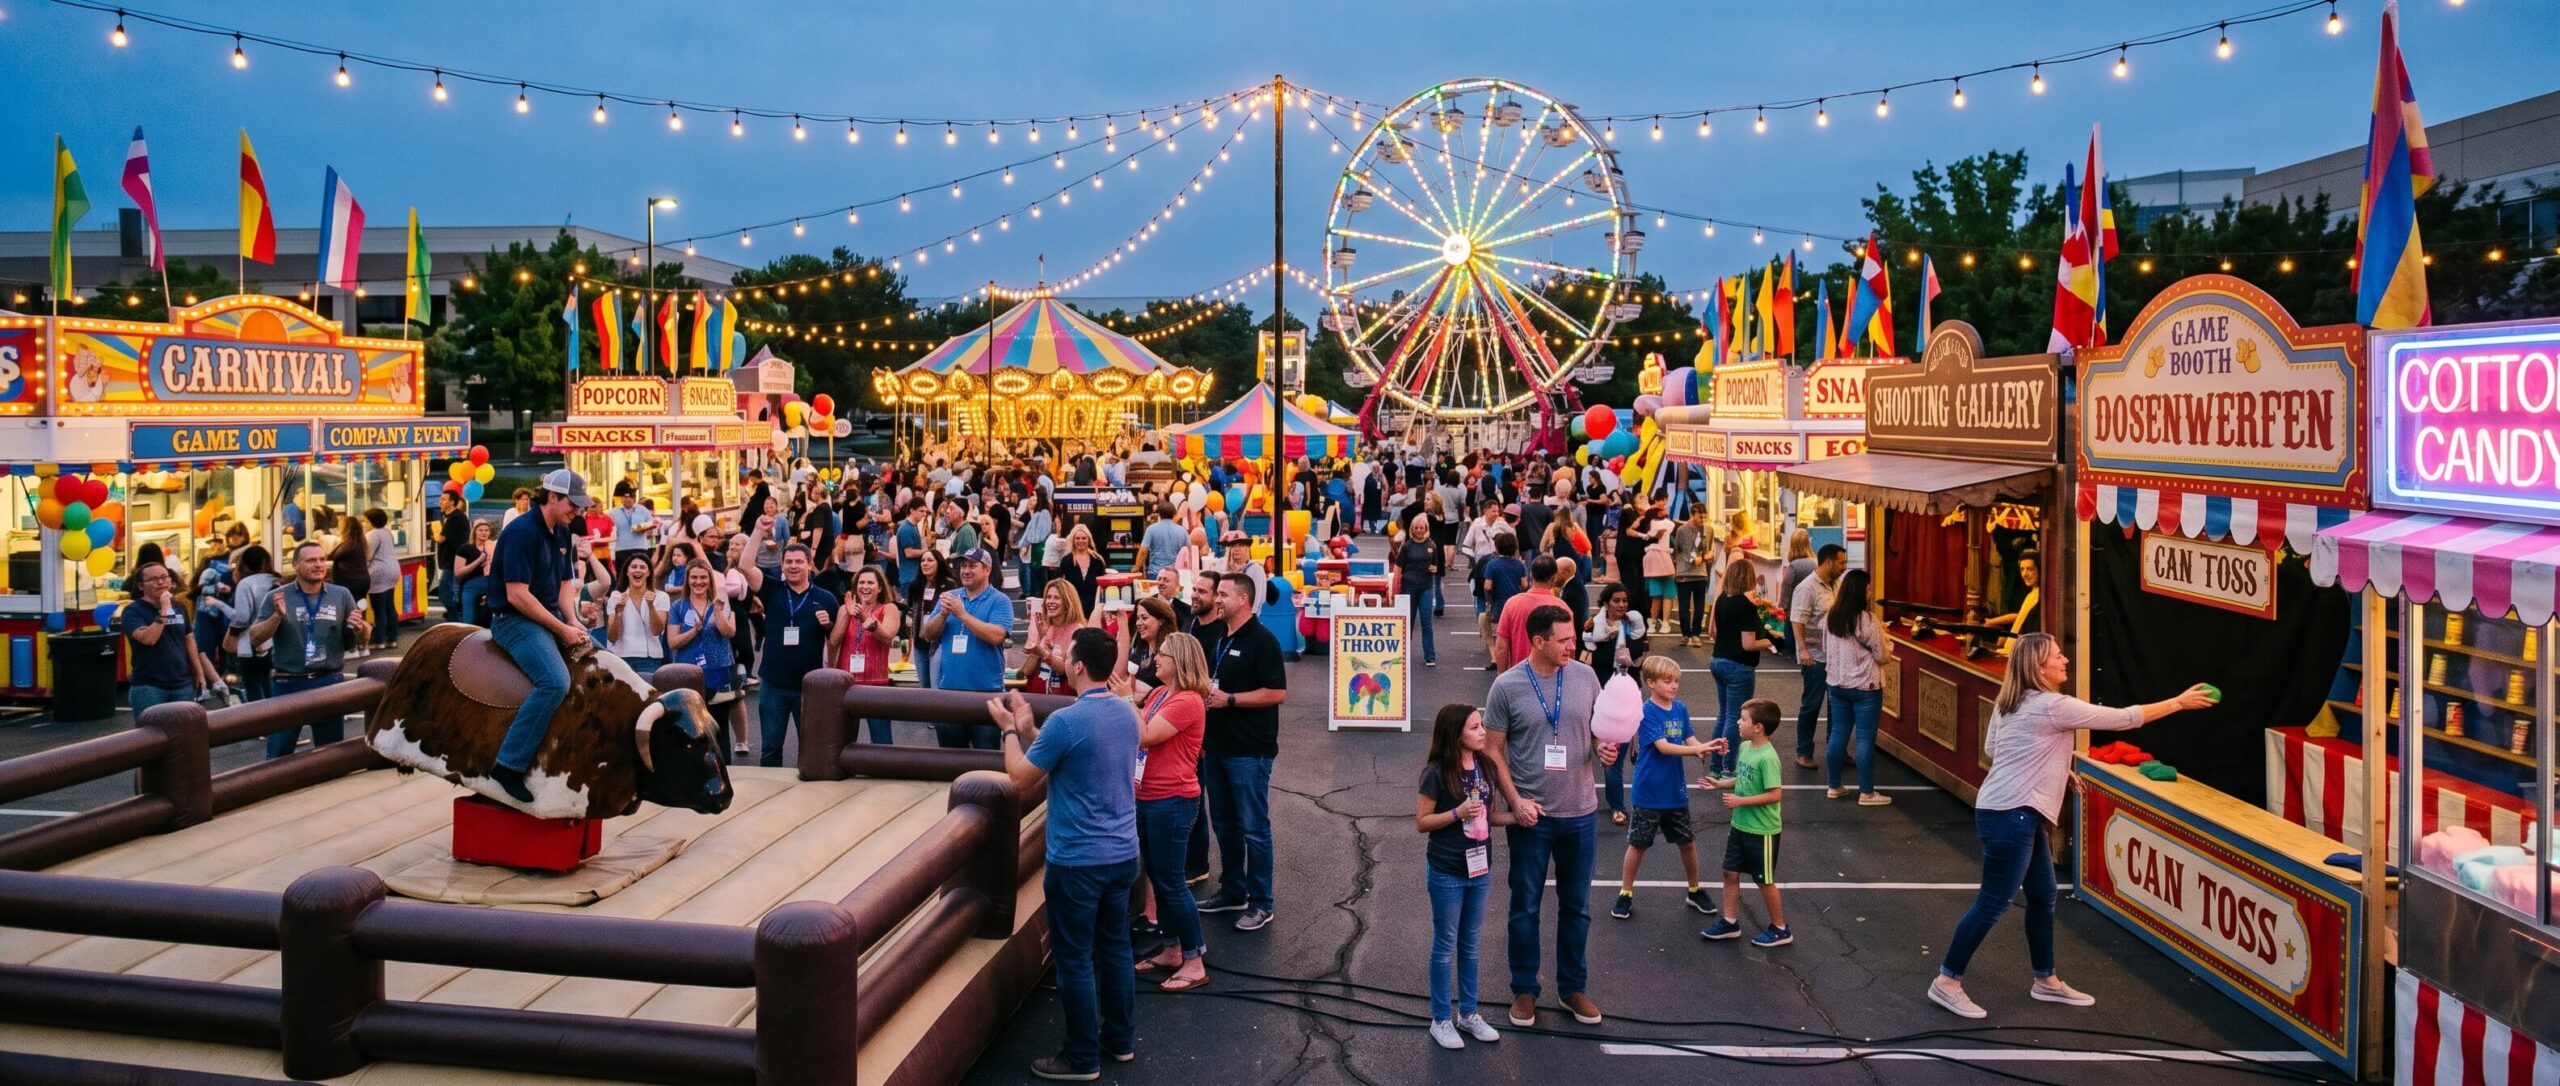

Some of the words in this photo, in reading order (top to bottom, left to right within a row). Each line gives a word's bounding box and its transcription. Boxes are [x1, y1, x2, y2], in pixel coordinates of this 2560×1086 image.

[2171, 316, 2229, 345] GAME
[162, 344, 353, 397] CARNIVAL
[2170, 347, 2232, 376] BOOTH
[583, 387, 661, 406] POPCORN
[689, 387, 729, 407] SNACKS
[1725, 373, 1769, 406] POPCORN
[1816, 377, 1867, 404] SNA
[2399, 352, 2560, 414] COTTO
[1874, 385, 1950, 427] SHOOTING
[1955, 379, 2044, 429] GALLERY
[2094, 389, 2335, 452] DOSENWERFEN
[172, 429, 240, 454] GAME
[247, 428, 278, 451] ON
[330, 426, 408, 448] COMPANY
[413, 425, 462, 445] EVENT
[565, 430, 647, 443] SNACKS
[1736, 441, 1792, 455] SNACKS
[2154, 545, 2193, 584] CAN
[2200, 552, 2257, 597] TOSS
[1344, 623, 1396, 636] DART
[1341, 639, 1400, 653] THROW
[2127, 836, 2185, 912] CAN
[2197, 873, 2279, 966] TOSS
